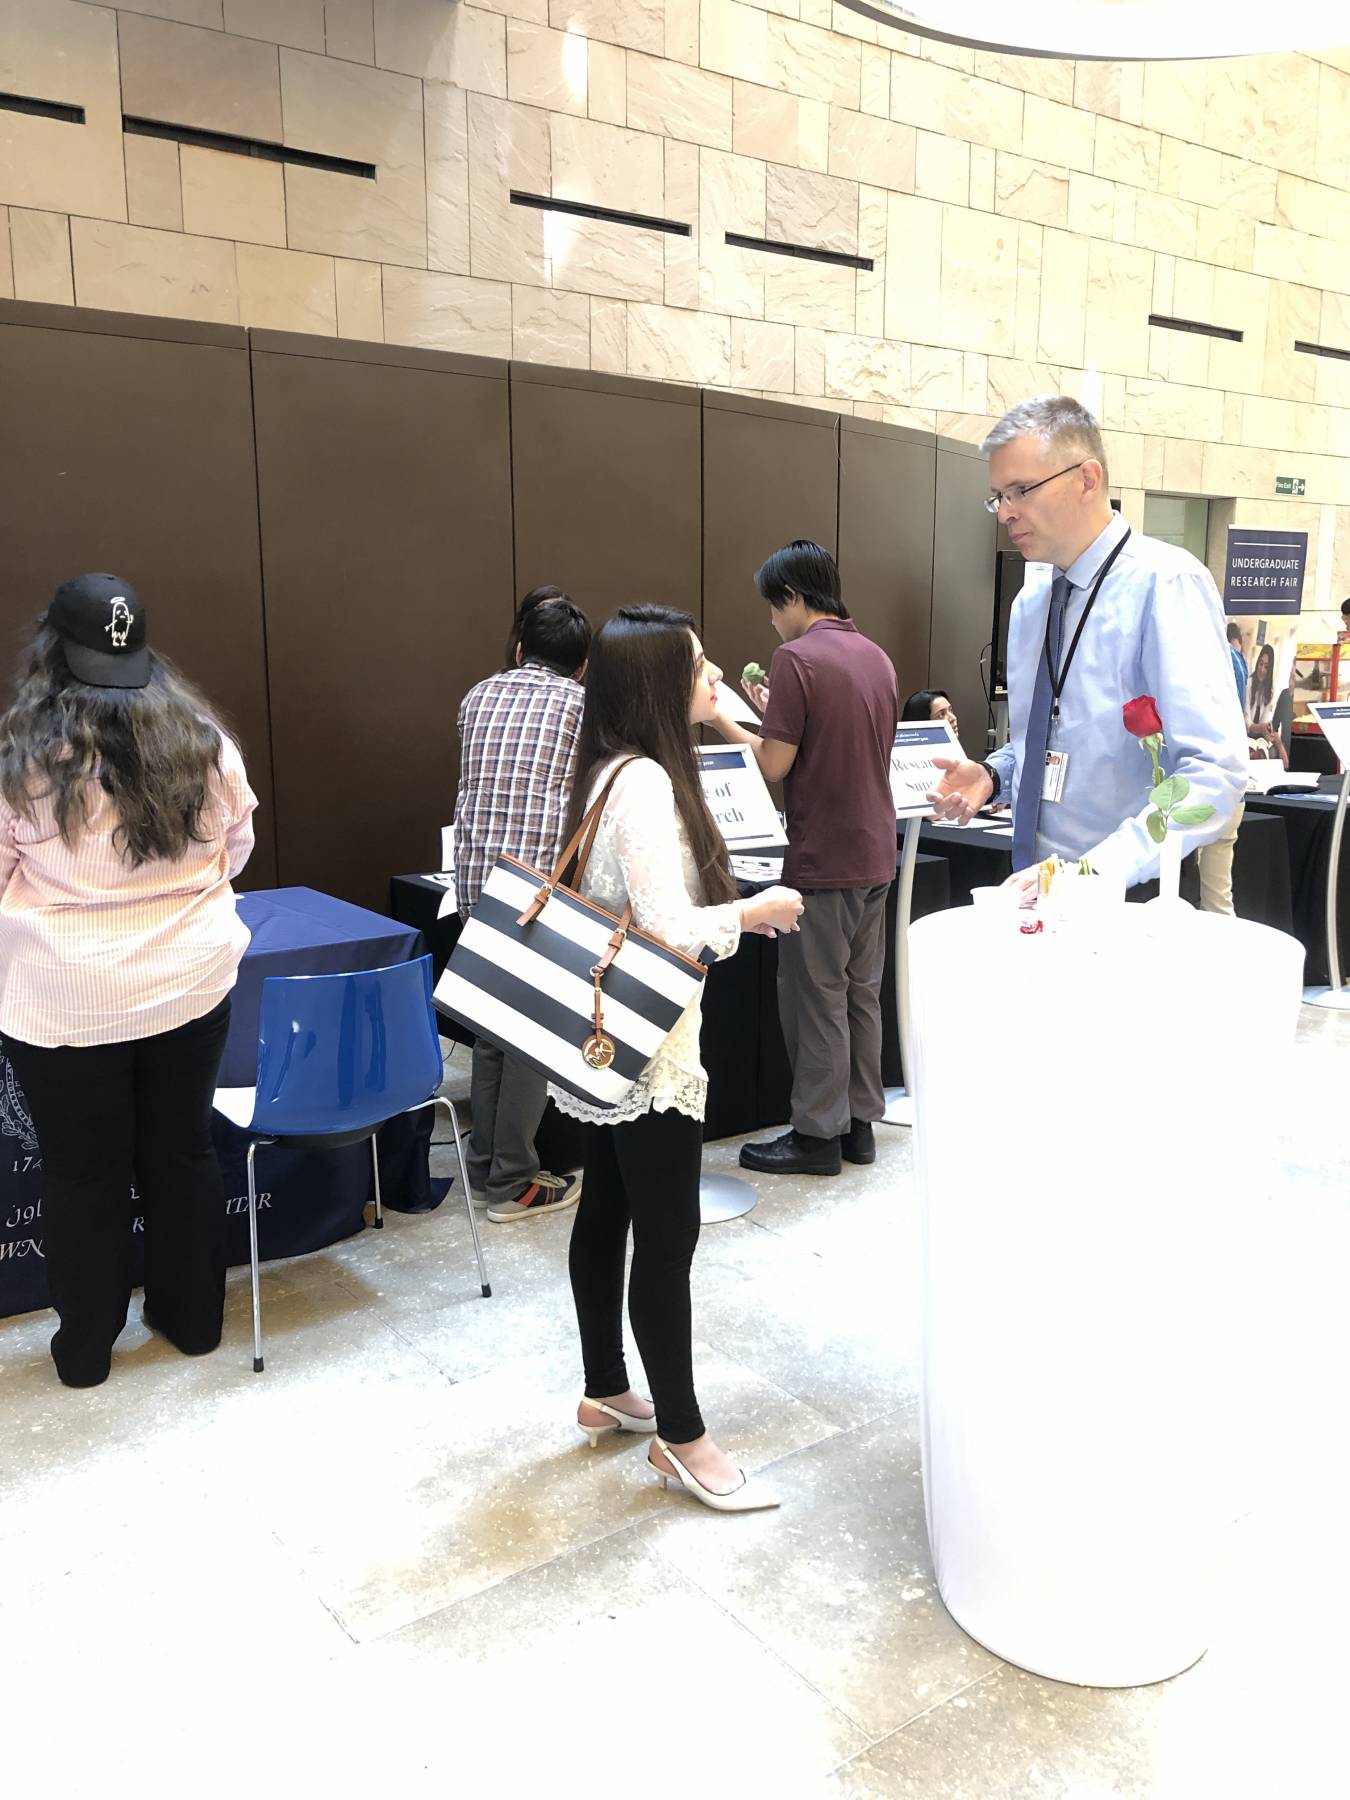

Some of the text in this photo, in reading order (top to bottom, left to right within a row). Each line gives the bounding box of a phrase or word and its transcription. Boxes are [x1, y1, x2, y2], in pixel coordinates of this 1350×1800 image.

[1232, 558, 1299, 569] UNDERGRADUATE
[1230, 576, 1297, 587] RESEARCH FAIR
